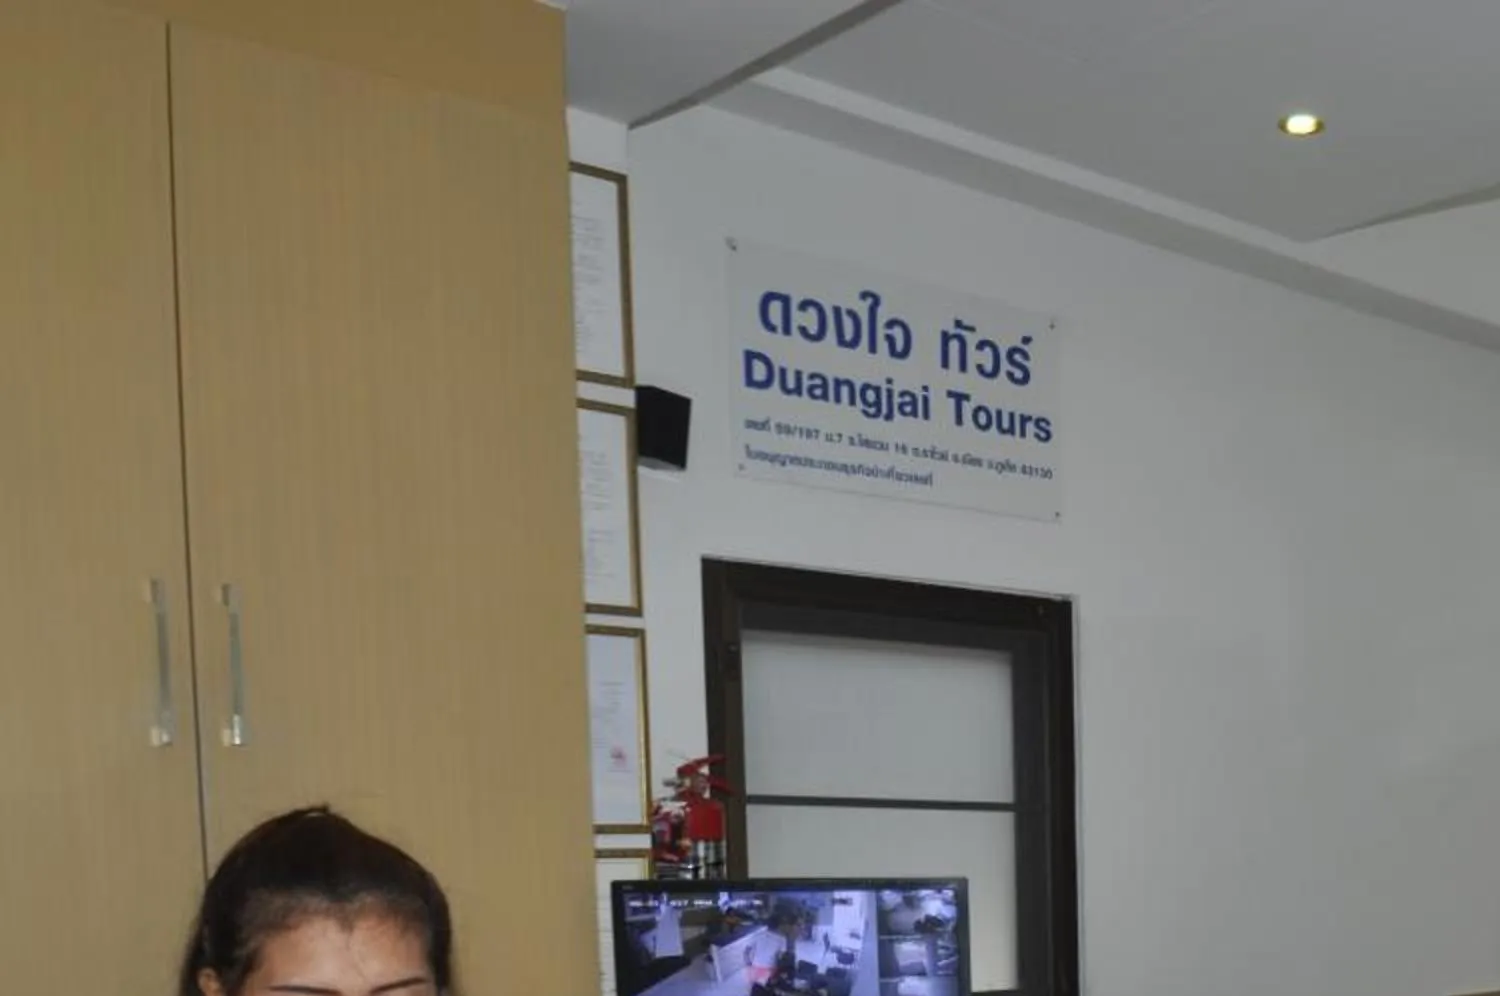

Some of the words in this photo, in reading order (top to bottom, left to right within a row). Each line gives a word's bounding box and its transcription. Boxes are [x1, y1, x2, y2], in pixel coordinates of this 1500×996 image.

[759, 290, 912, 360] ดวงใจ
[940, 318, 1033, 386] ทัวร์
[743, 349, 931, 421] Duangjai
[946, 389, 1053, 443] Tours
